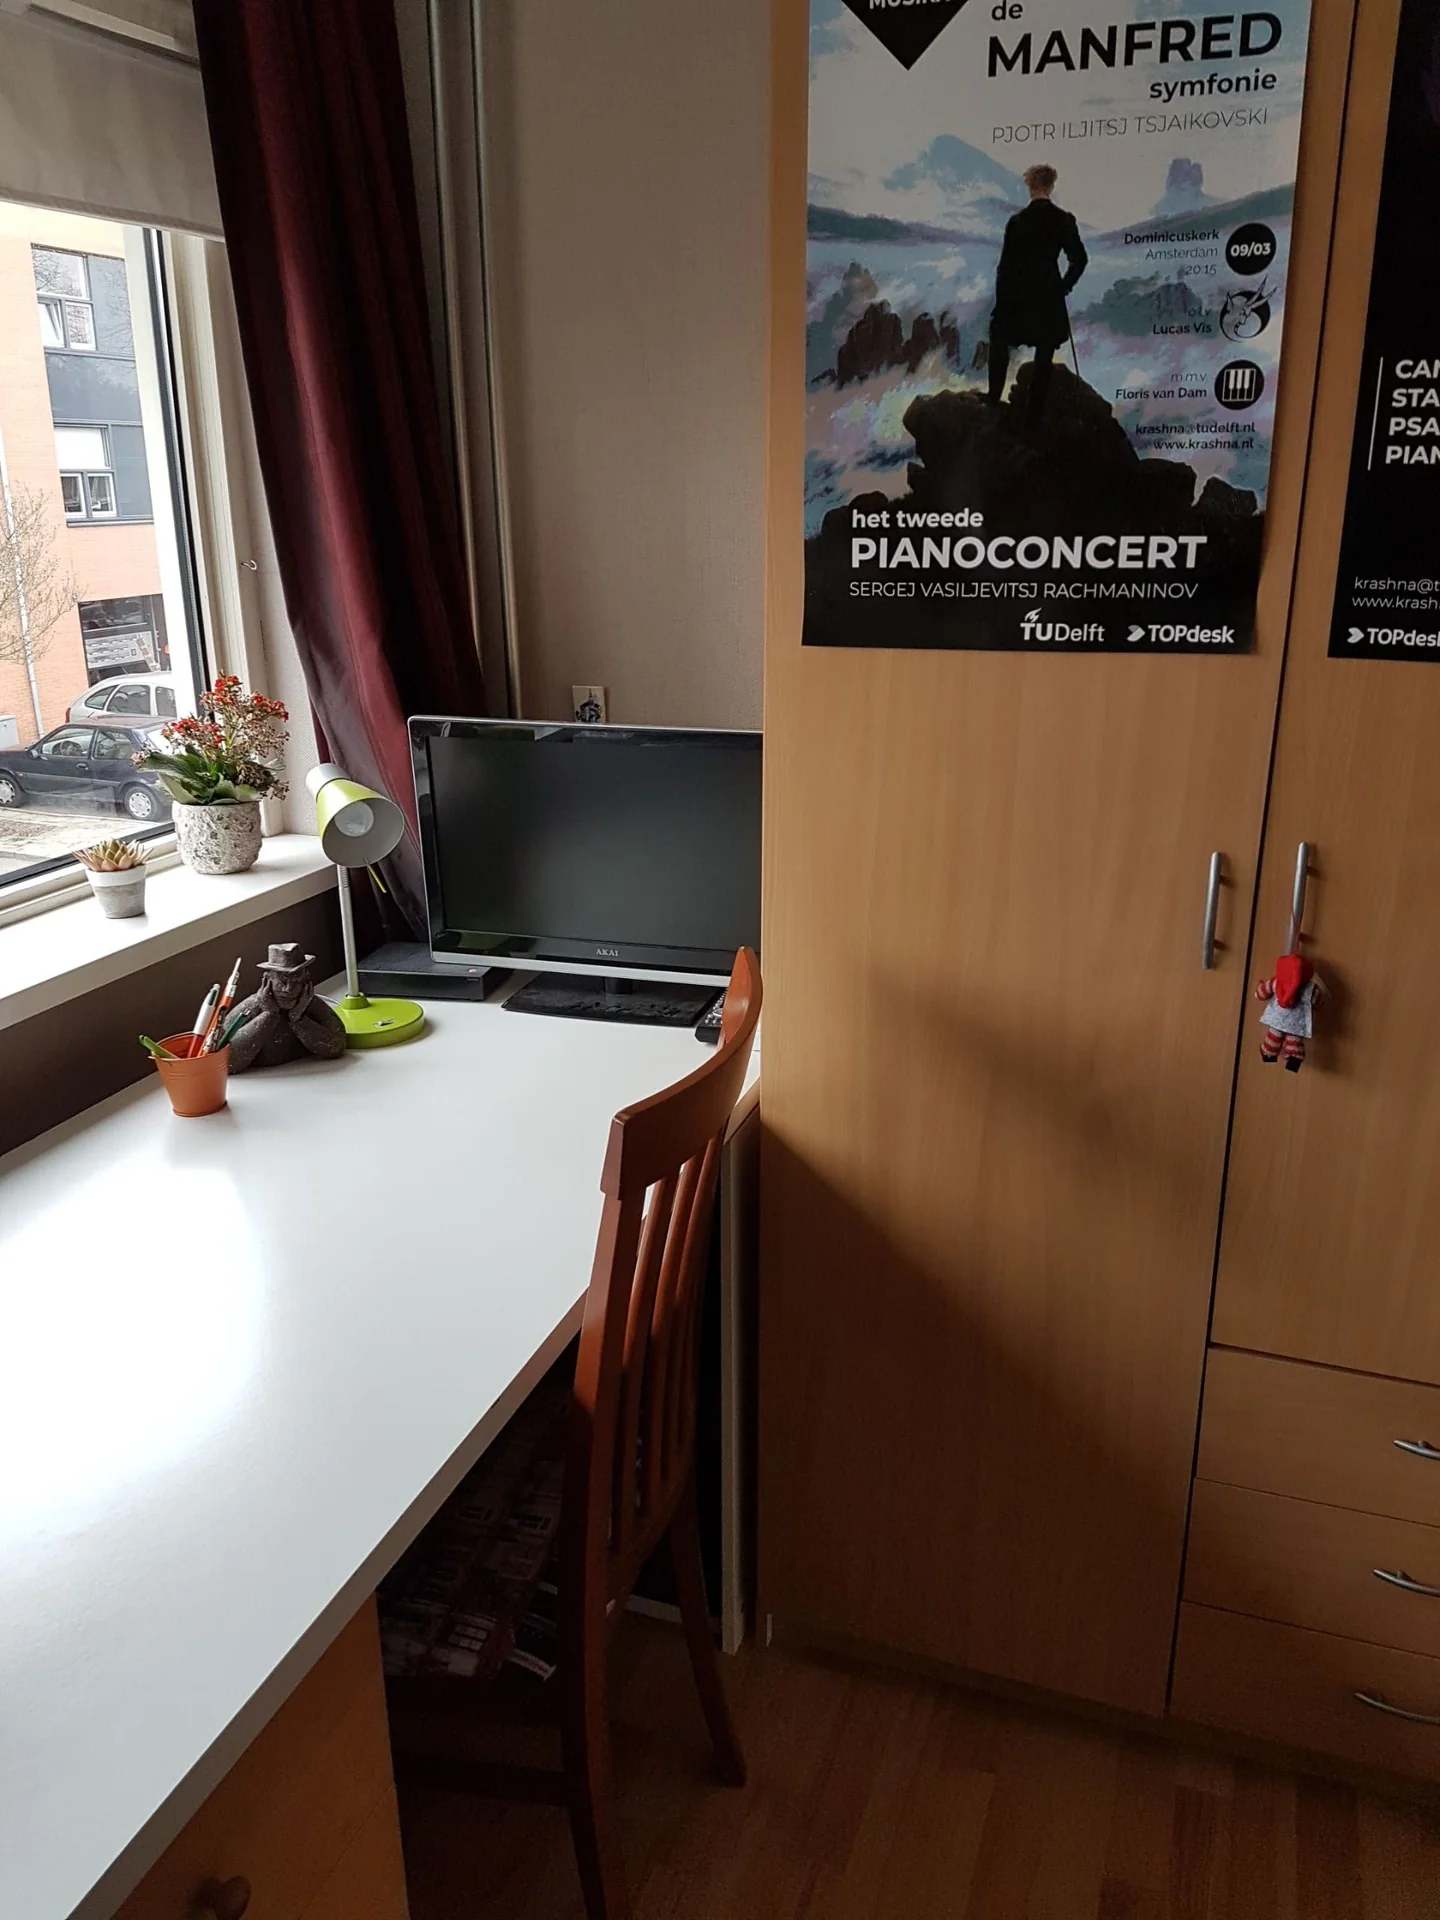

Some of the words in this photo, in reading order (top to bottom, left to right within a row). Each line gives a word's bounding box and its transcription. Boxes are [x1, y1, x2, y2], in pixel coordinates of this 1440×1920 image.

[991, 0, 1023, 20] de
[987, 12, 1283, 77] MANFRED
[1149, 68, 1277, 103] symfonie
[992, 124, 1056, 144] PJOTR
[1061, 117, 1128, 138] ILJITSJ
[1134, 106, 1268, 134] TSJAIKOVSKI
[1124, 229, 1220, 245] Dominicuskerk
[1145, 248, 1218, 260] Amsterdam
[1230, 242, 1271, 257] 09/03
[1185, 264, 1217, 275] 2015
[1153, 324, 1190, 335] Lucas
[1193, 322, 1212, 333] Vis
[1115, 388, 1150, 400] Floris
[1152, 390, 1175, 399] van
[1178, 387, 1207, 398] Dam
[1153, 438, 1254, 450] www.krashna.nl
[852, 508, 890, 529] het
[896, 508, 984, 528] tweede
[851, 535, 1208, 569] PIANOCONCERT
[849, 581, 916, 598] SERGEJ
[920, 582, 1038, 599] VASILJEVITSJ
[1043, 583, 1199, 599] RACHMANINOV
[1148, 624, 1235, 644] TOPdesk
[595, 948, 619, 957] AKAI
